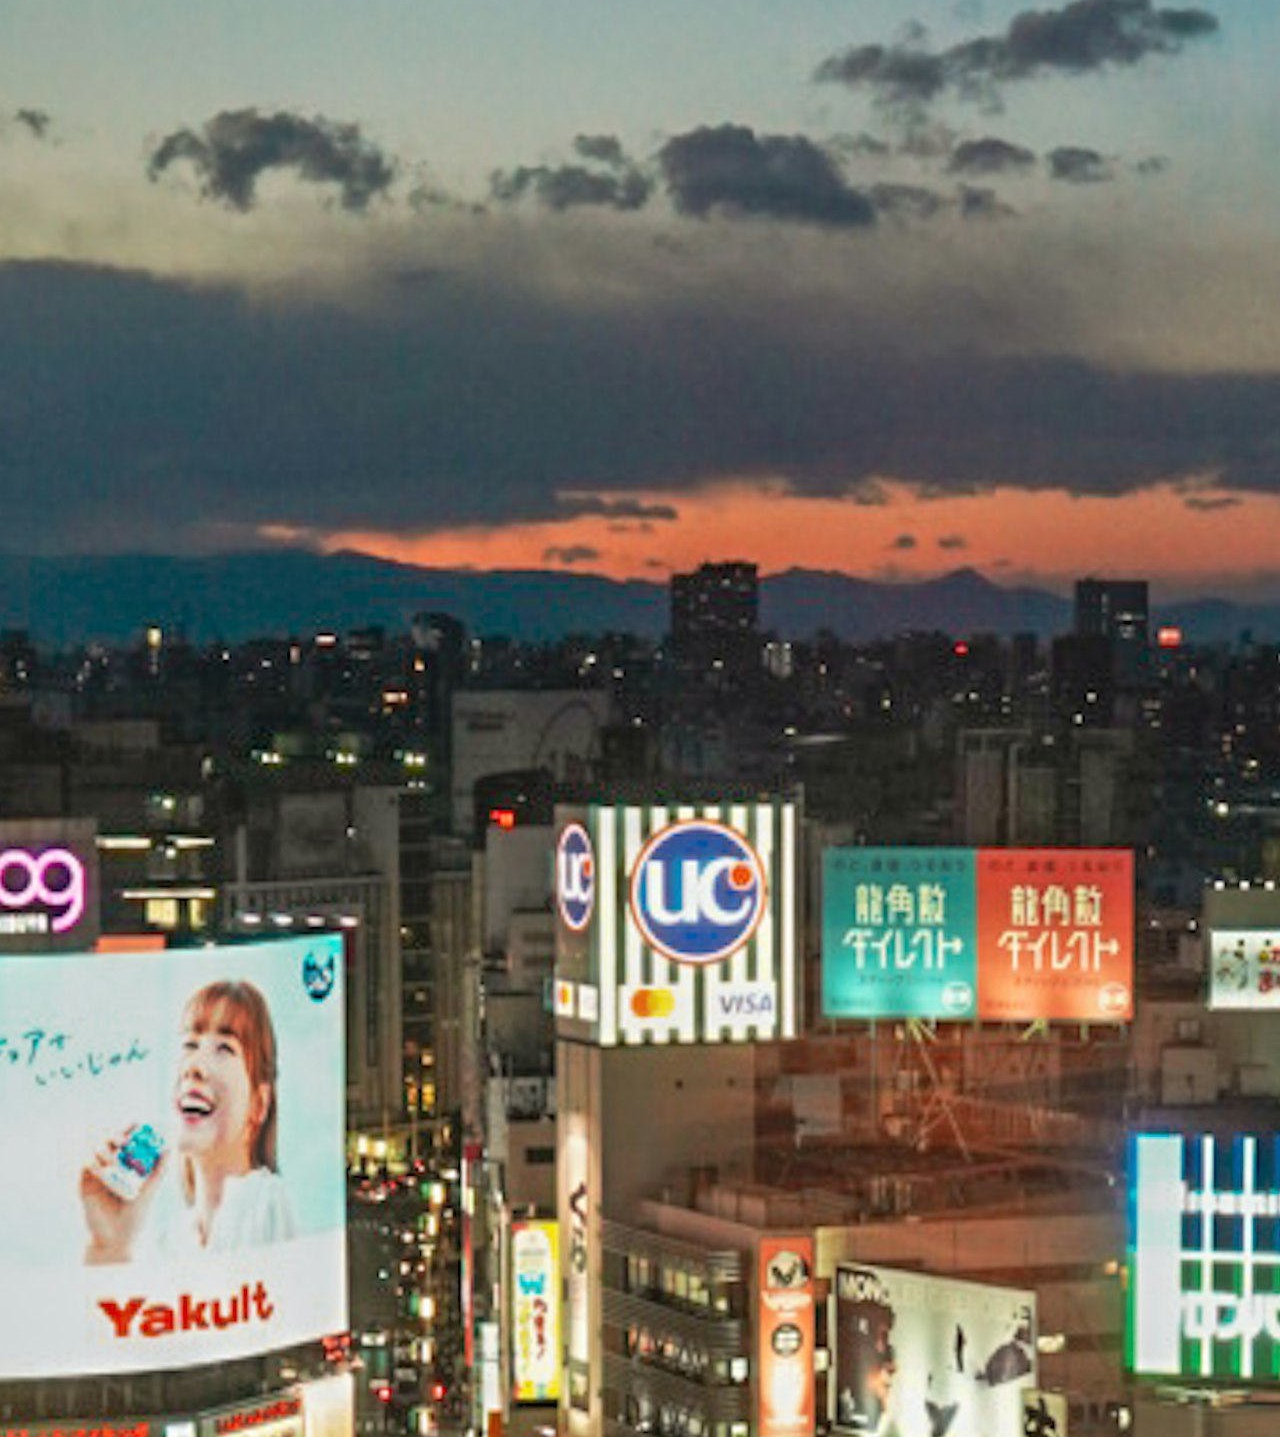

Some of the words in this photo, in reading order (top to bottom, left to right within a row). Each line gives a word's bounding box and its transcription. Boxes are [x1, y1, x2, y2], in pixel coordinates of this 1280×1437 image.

[644, 856, 754, 926] UC
[842, 928, 964, 970] ダイレクト
[997, 930, 1120, 972] ダイレクト
[721, 994, 773, 1015] VISA
[97, 1280, 275, 1338] Yakult
